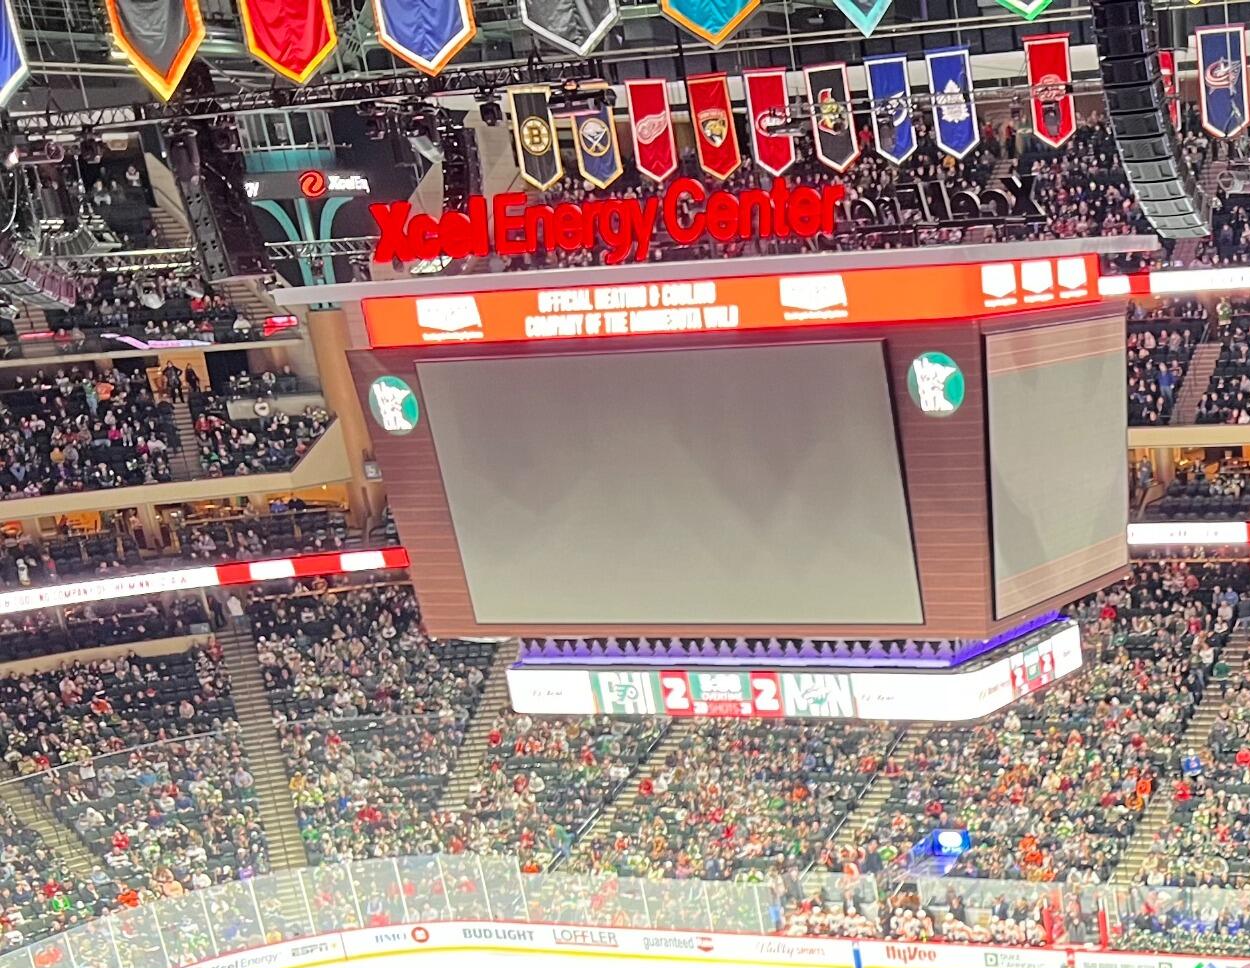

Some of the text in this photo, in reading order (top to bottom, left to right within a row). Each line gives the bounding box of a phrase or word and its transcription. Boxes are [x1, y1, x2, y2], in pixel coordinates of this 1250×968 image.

[369, 176, 845, 265] Xcel Energy Center
[600, 671, 656, 715] PHI
[662, 676, 690, 710] 2
[752, 678, 780, 711] 2
[783, 673, 853, 717] MIN
[463, 927, 535, 942] BUD LIGHT
[553, 928, 619, 945] LOFFLER
[643, 936, 694, 951] guaranteed
